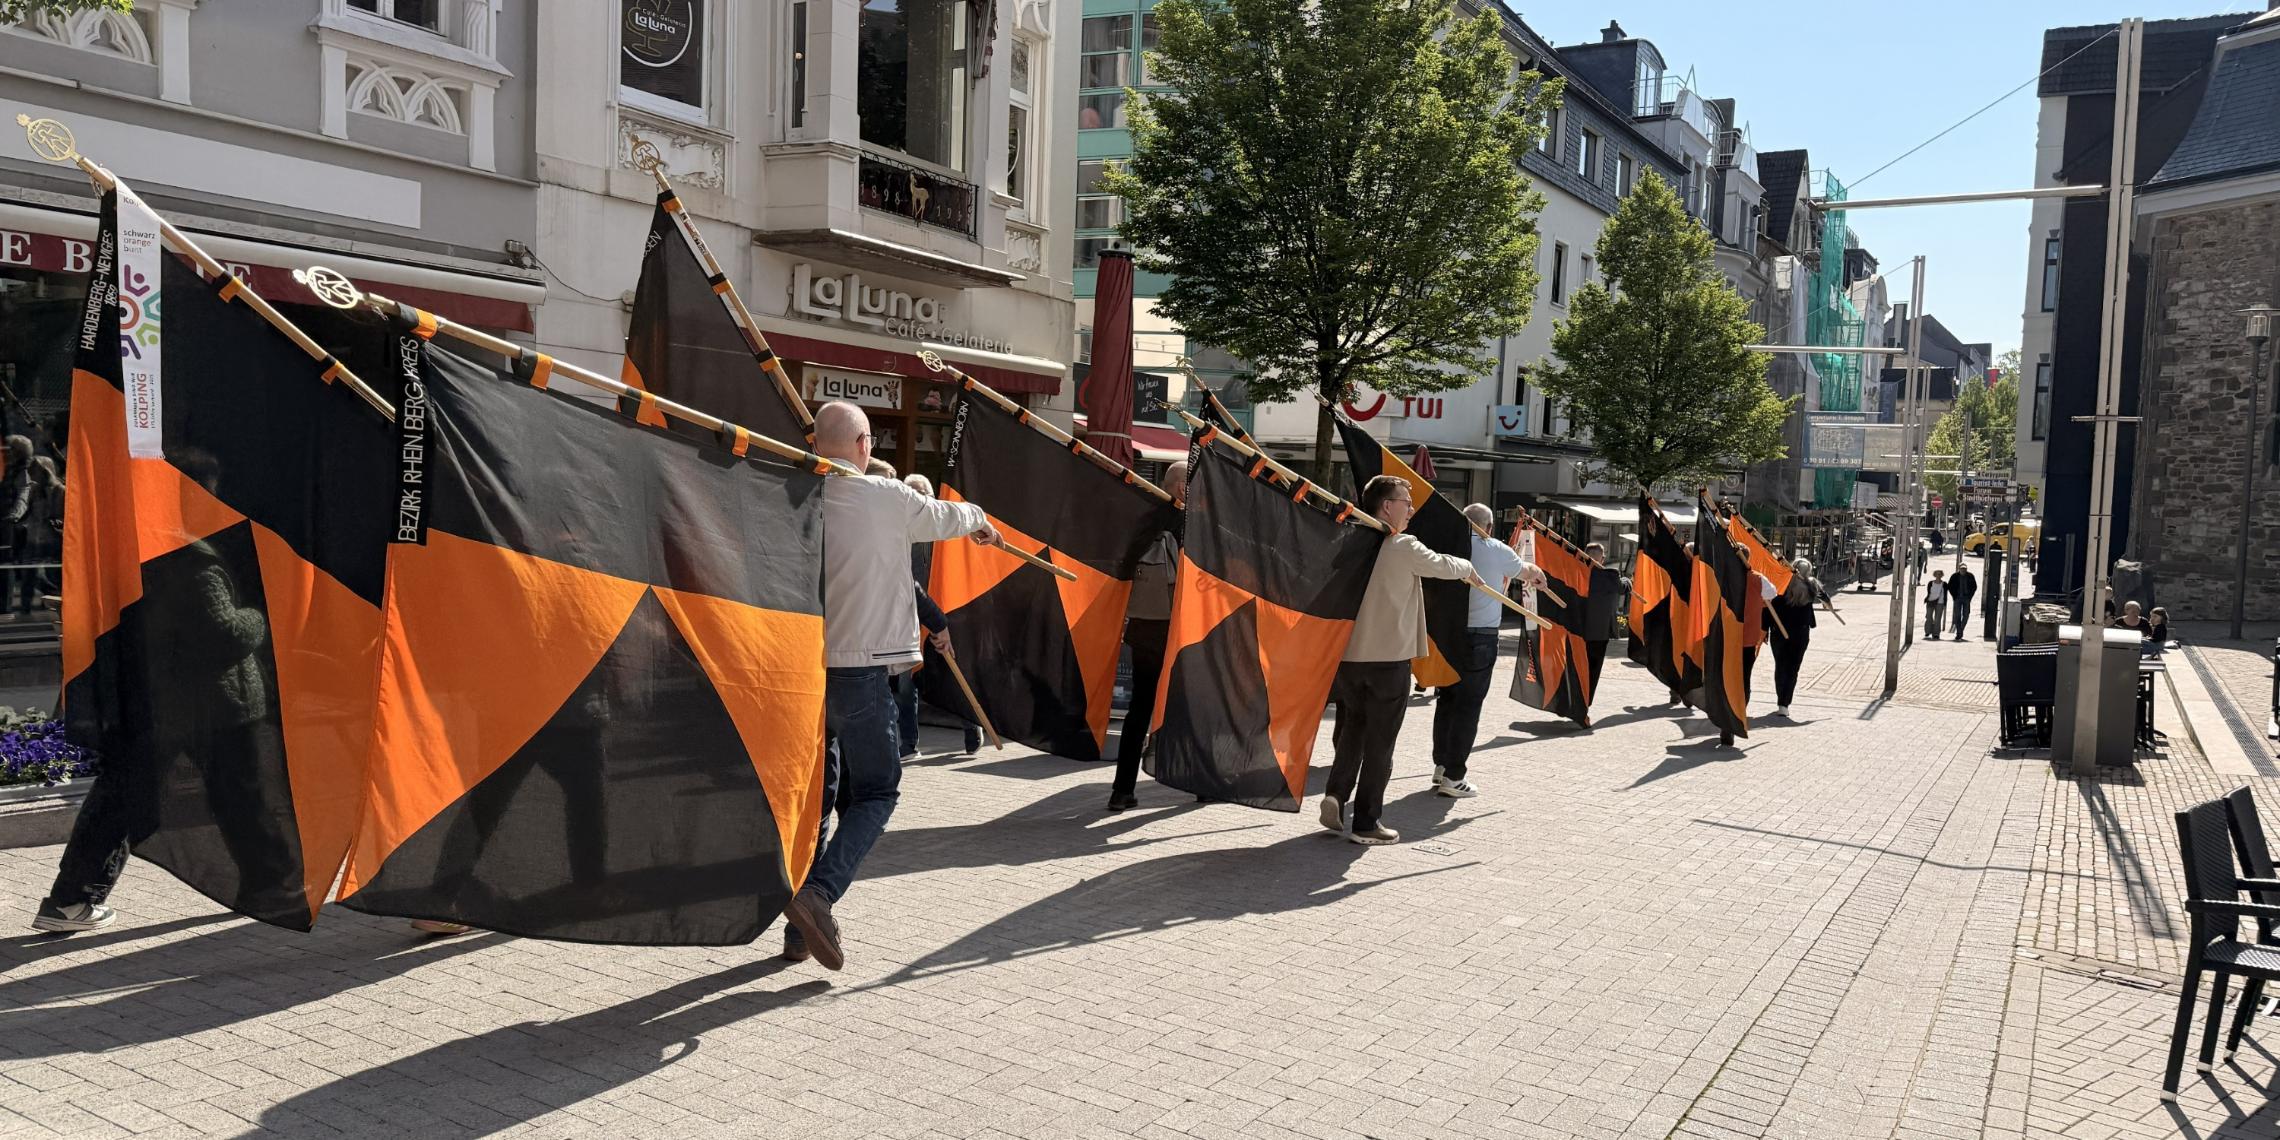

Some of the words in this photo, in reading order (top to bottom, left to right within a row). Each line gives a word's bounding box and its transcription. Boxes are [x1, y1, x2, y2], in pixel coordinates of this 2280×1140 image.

[123, 229, 156, 239] schwarz
[123, 238, 152, 247] orange
[123, 245, 142, 254] bunt
[80, 229, 115, 351] HARDENBERG-NEVIGES
[885, 317, 927, 340] Café
[941, 327, 1014, 355] Gelateria
[400, 336, 419, 380] KREIS
[137, 373, 149, 429] KOLPING
[1403, 396, 1443, 419] TUI
[398, 489, 422, 542] BEZIRK
